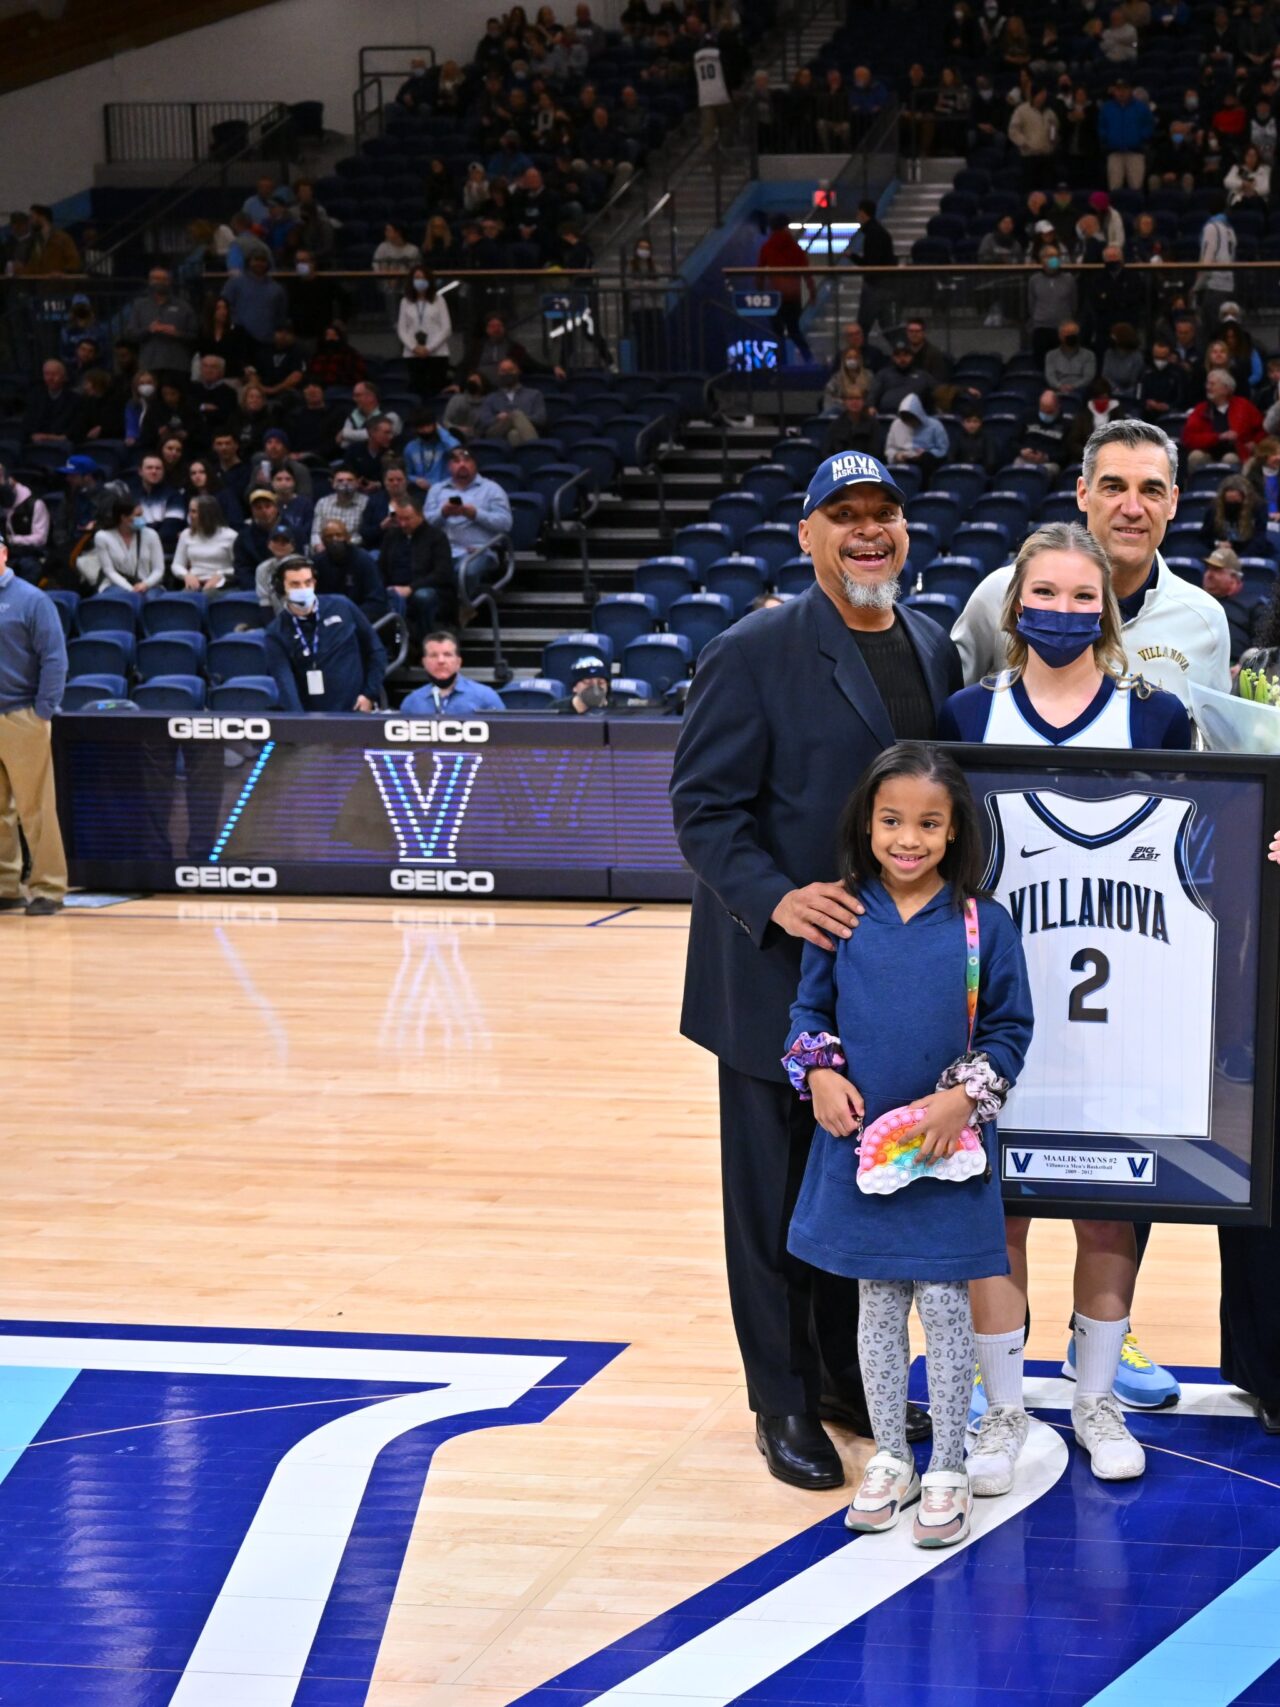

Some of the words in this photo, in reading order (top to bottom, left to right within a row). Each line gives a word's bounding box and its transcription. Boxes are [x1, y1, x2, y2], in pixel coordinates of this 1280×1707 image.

[745, 295, 771, 307] 102
[831, 455, 880, 474] NOVA
[832, 467, 882, 482] BASKETBALL
[1137, 646, 1190, 673] VILLANOVA
[168, 717, 272, 740] GEICO
[384, 719, 489, 743] GEICO
[1130, 853, 1161, 861] EAST
[1134, 846, 1157, 854] BIG
[175, 866, 277, 888] GEICO
[390, 869, 494, 893] GEICO
[1009, 877, 1172, 945] VILLANOVA
[1068, 947, 1110, 1024] 2
[1011, 1152, 1033, 1173] V
[1043, 1154, 1077, 1163] MAALIK
[1079, 1156, 1108, 1164] WAYNS
[1127, 1157, 1149, 1178] V
